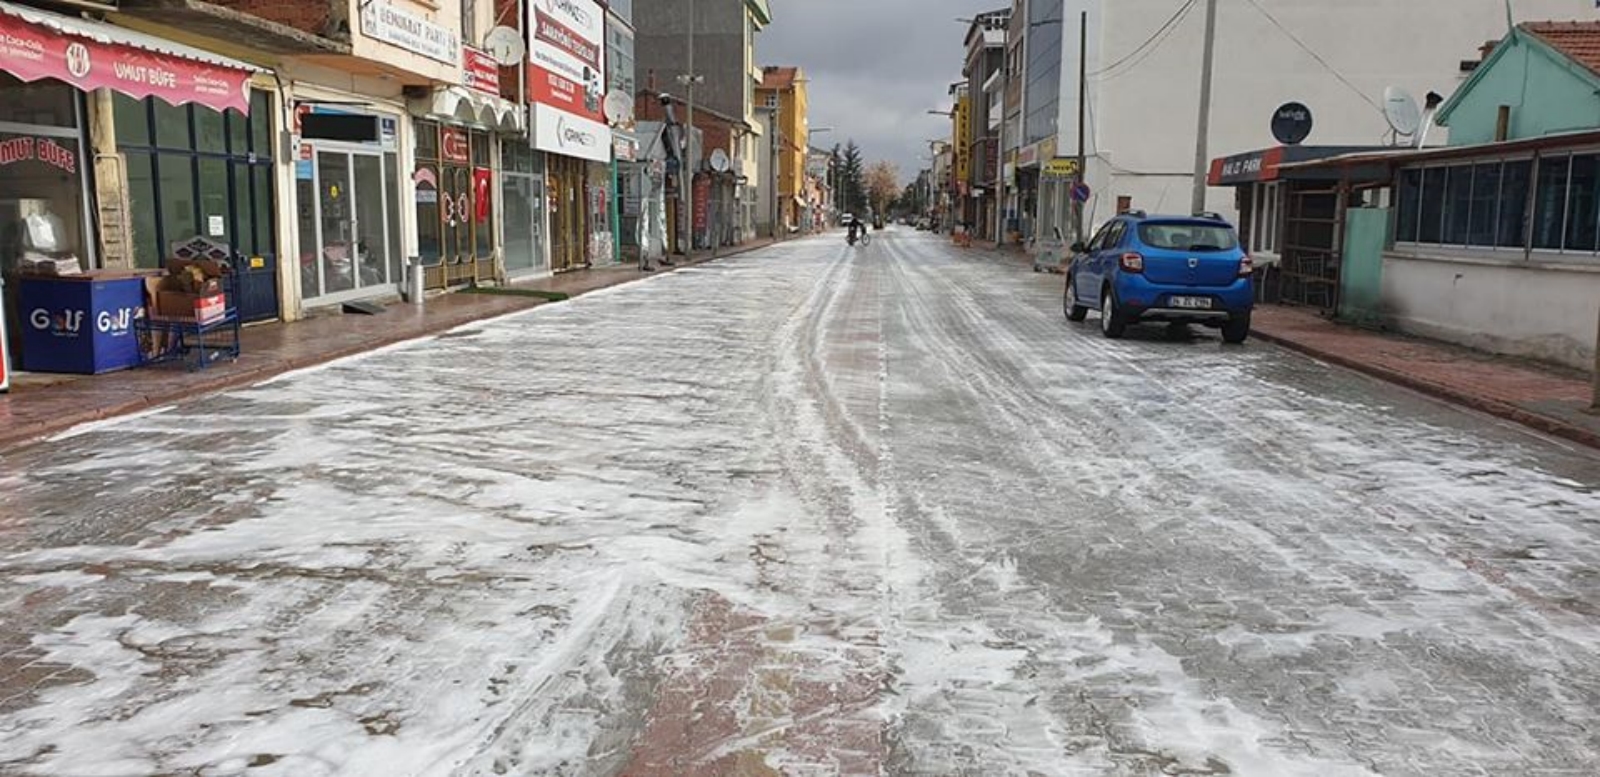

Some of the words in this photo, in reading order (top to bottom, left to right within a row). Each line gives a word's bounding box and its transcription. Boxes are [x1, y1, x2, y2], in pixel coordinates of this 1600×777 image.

[113, 62, 148, 82] UMUT
[148, 67, 176, 88] BÜFE
[0, 136, 34, 165] MUT
[1242, 158, 1263, 175] PARK
[31, 308, 84, 332] Golf
[97, 307, 131, 333] Golf
